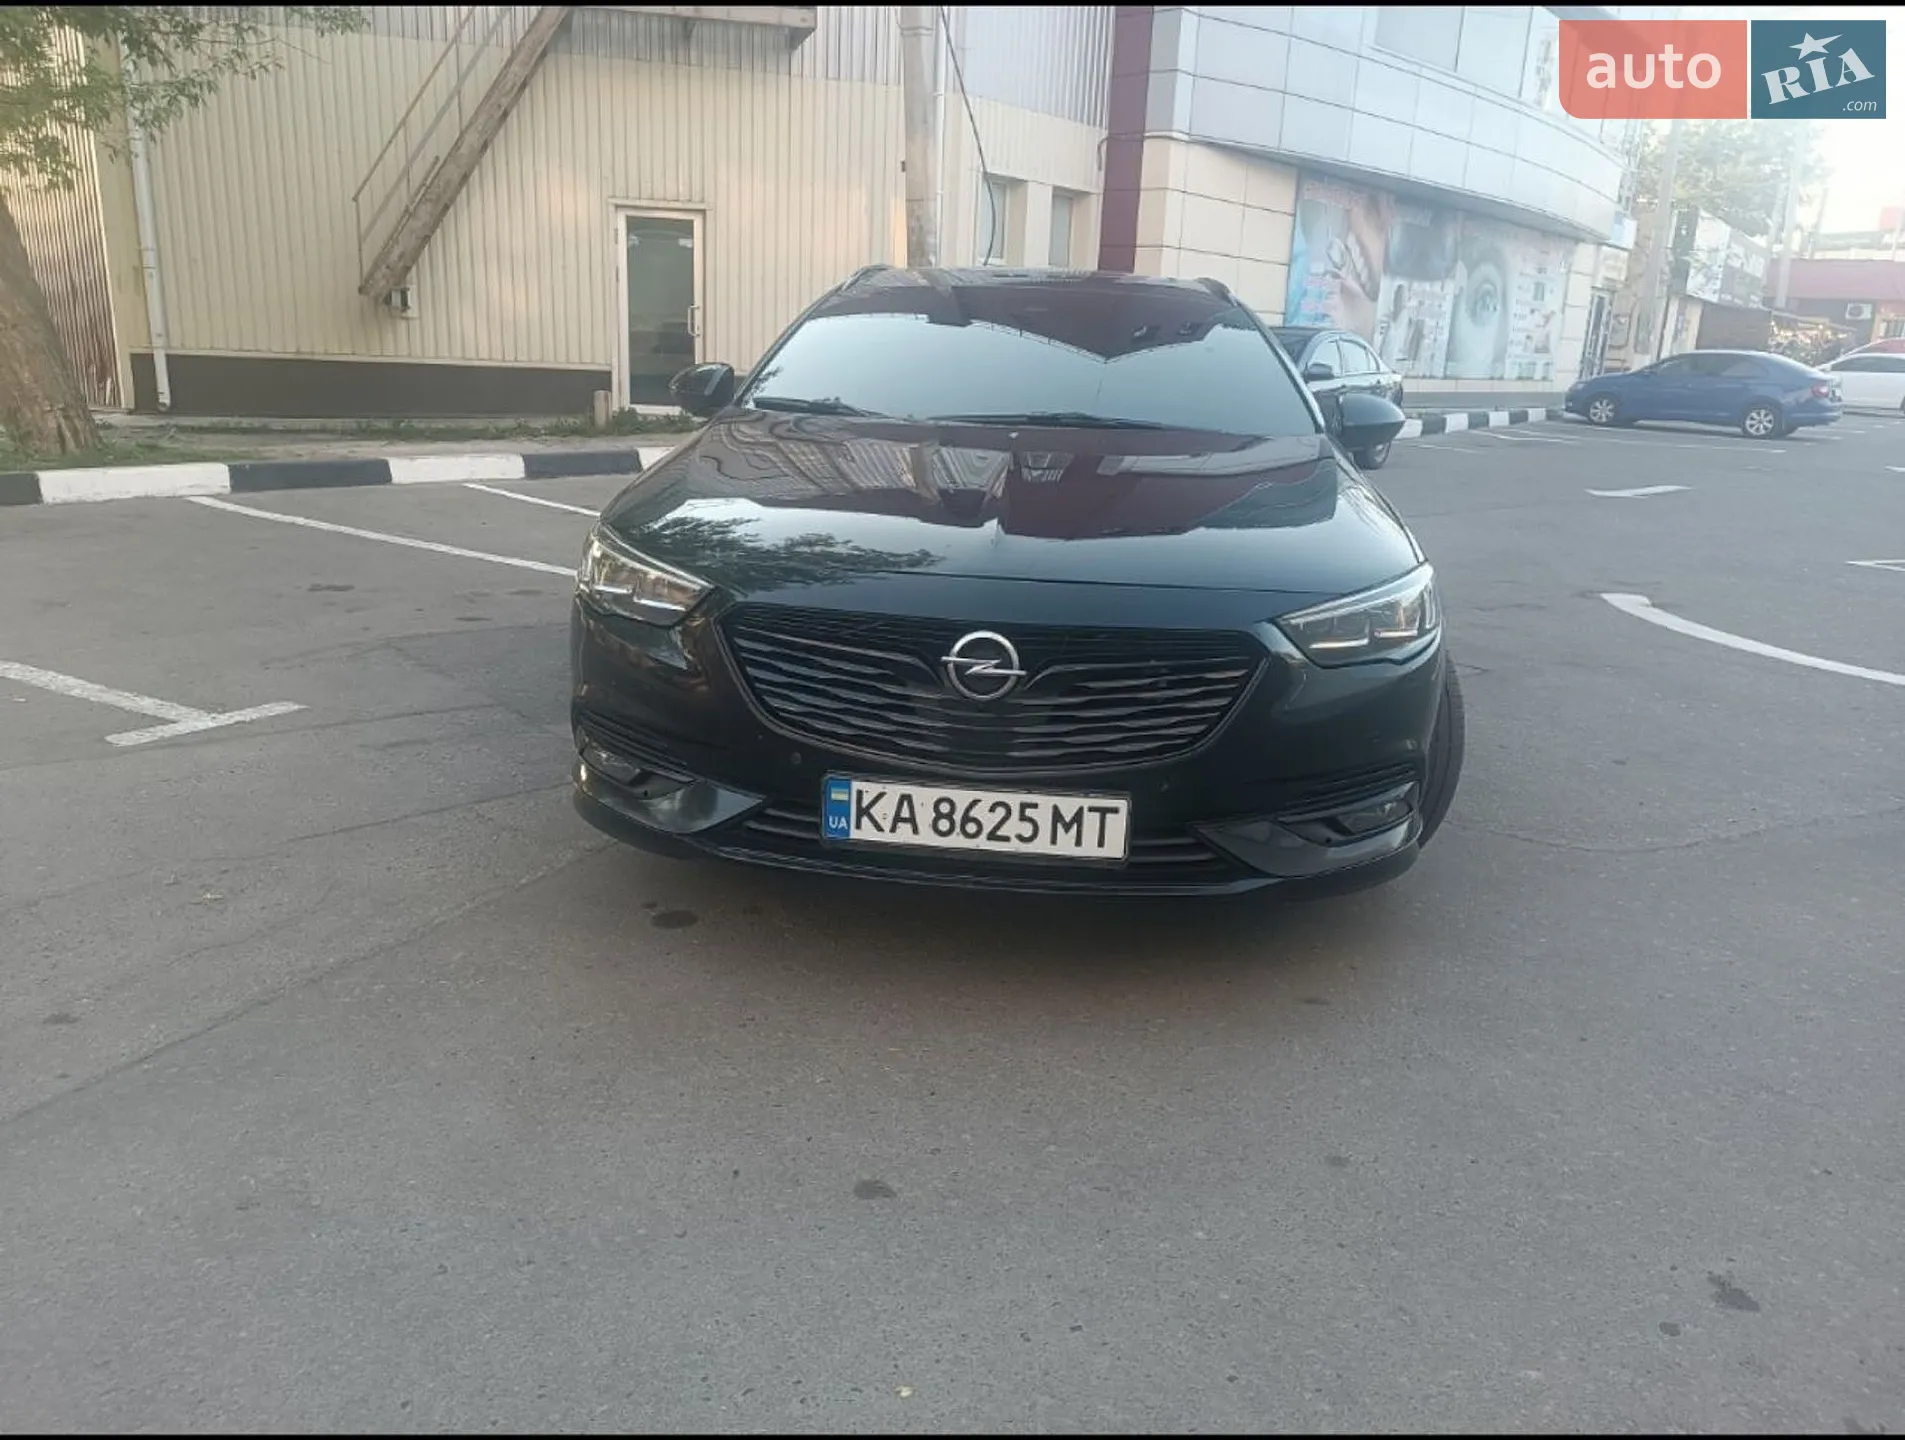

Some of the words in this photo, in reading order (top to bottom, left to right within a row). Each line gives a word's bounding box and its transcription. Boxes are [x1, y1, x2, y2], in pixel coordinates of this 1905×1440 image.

[828, 815, 848, 831] UA
[855, 788, 919, 835] KA
[931, 797, 1040, 843] 8625
[1050, 804, 1120, 848] MT
